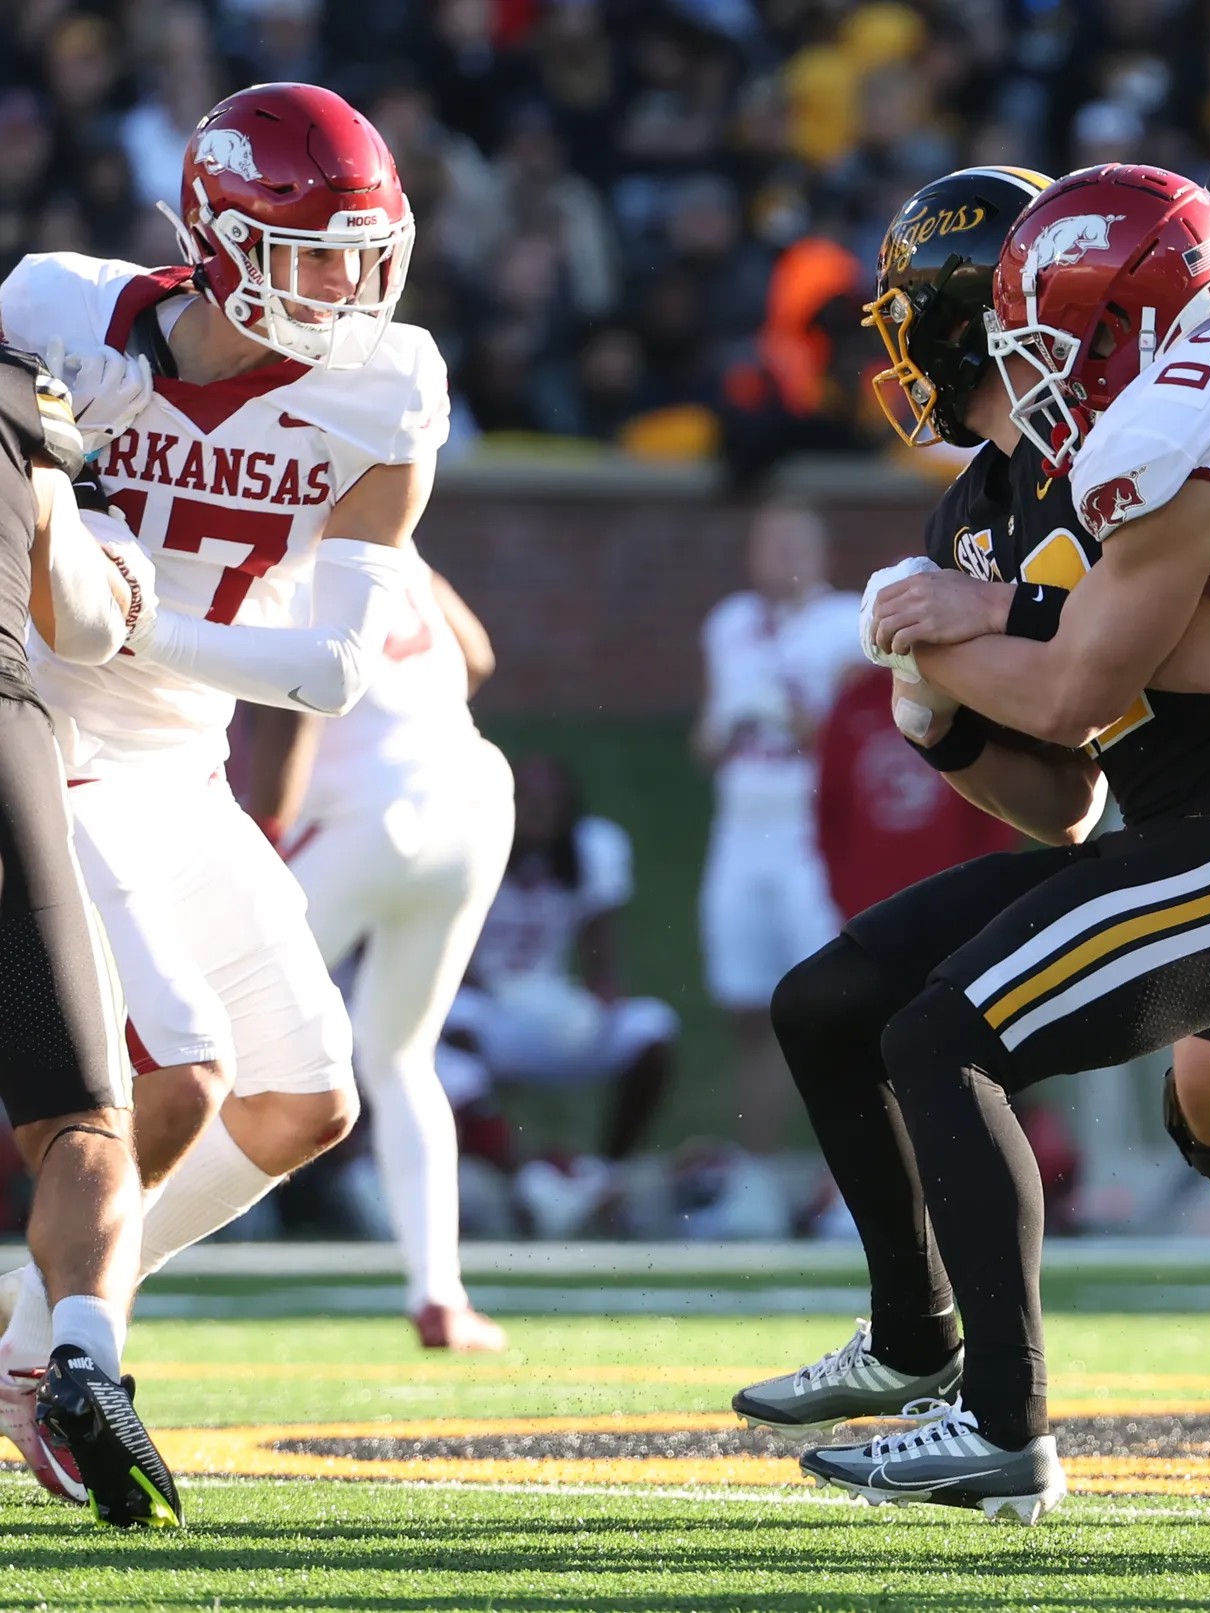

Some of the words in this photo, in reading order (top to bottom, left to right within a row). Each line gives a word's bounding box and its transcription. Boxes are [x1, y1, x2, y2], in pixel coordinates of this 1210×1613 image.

[346, 215, 378, 227] HOGS
[886, 205, 985, 273] Tigers
[90, 427, 331, 506] RKANSAS
[67, 1356, 95, 1371] NIKE
